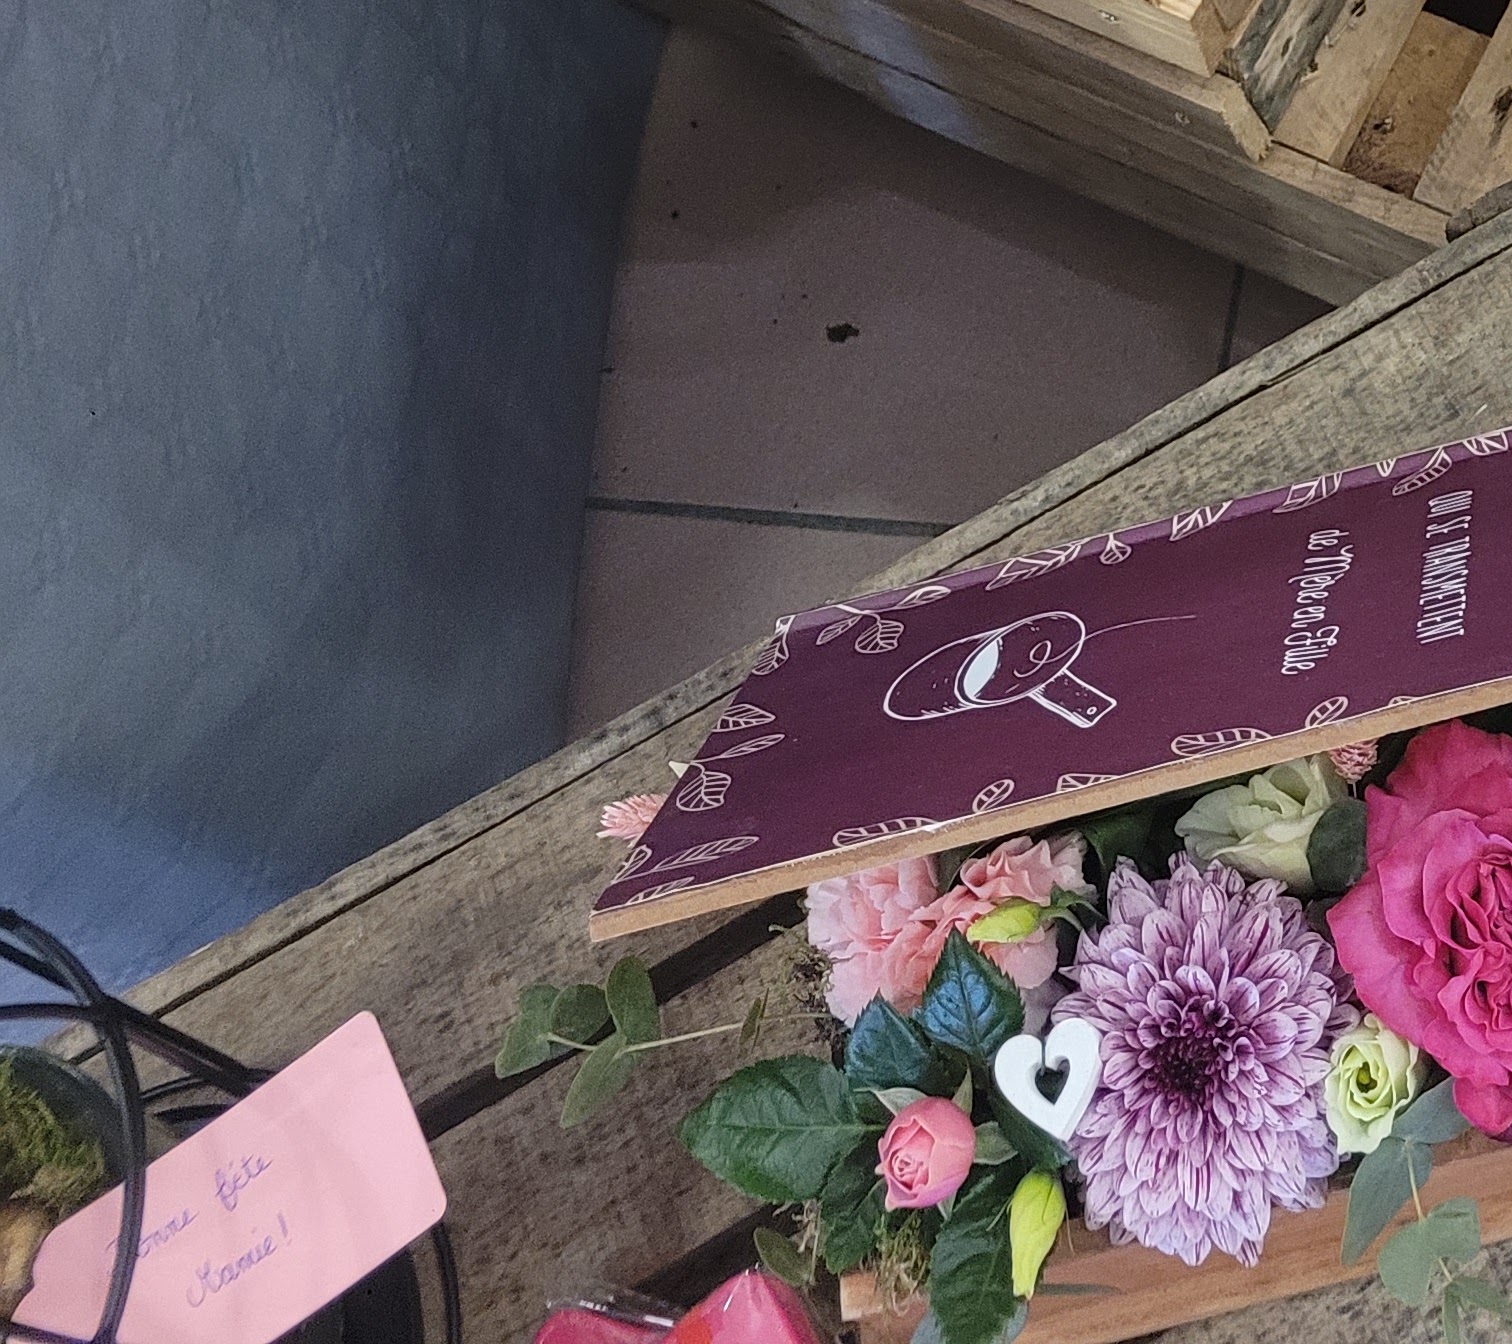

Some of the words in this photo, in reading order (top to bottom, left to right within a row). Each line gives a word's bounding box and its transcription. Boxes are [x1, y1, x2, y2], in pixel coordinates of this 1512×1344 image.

[1426, 489, 1474, 519] QUI
[1307, 529, 1351, 551] de
[1425, 515, 1473, 539] SE
[1287, 544, 1355, 604] Mère
[1415, 535, 1473, 645] TRANSMETTENT
[1290, 605, 1327, 628] en
[1280, 625, 1340, 675] Fille
[105, 1208, 200, 1275] onne
